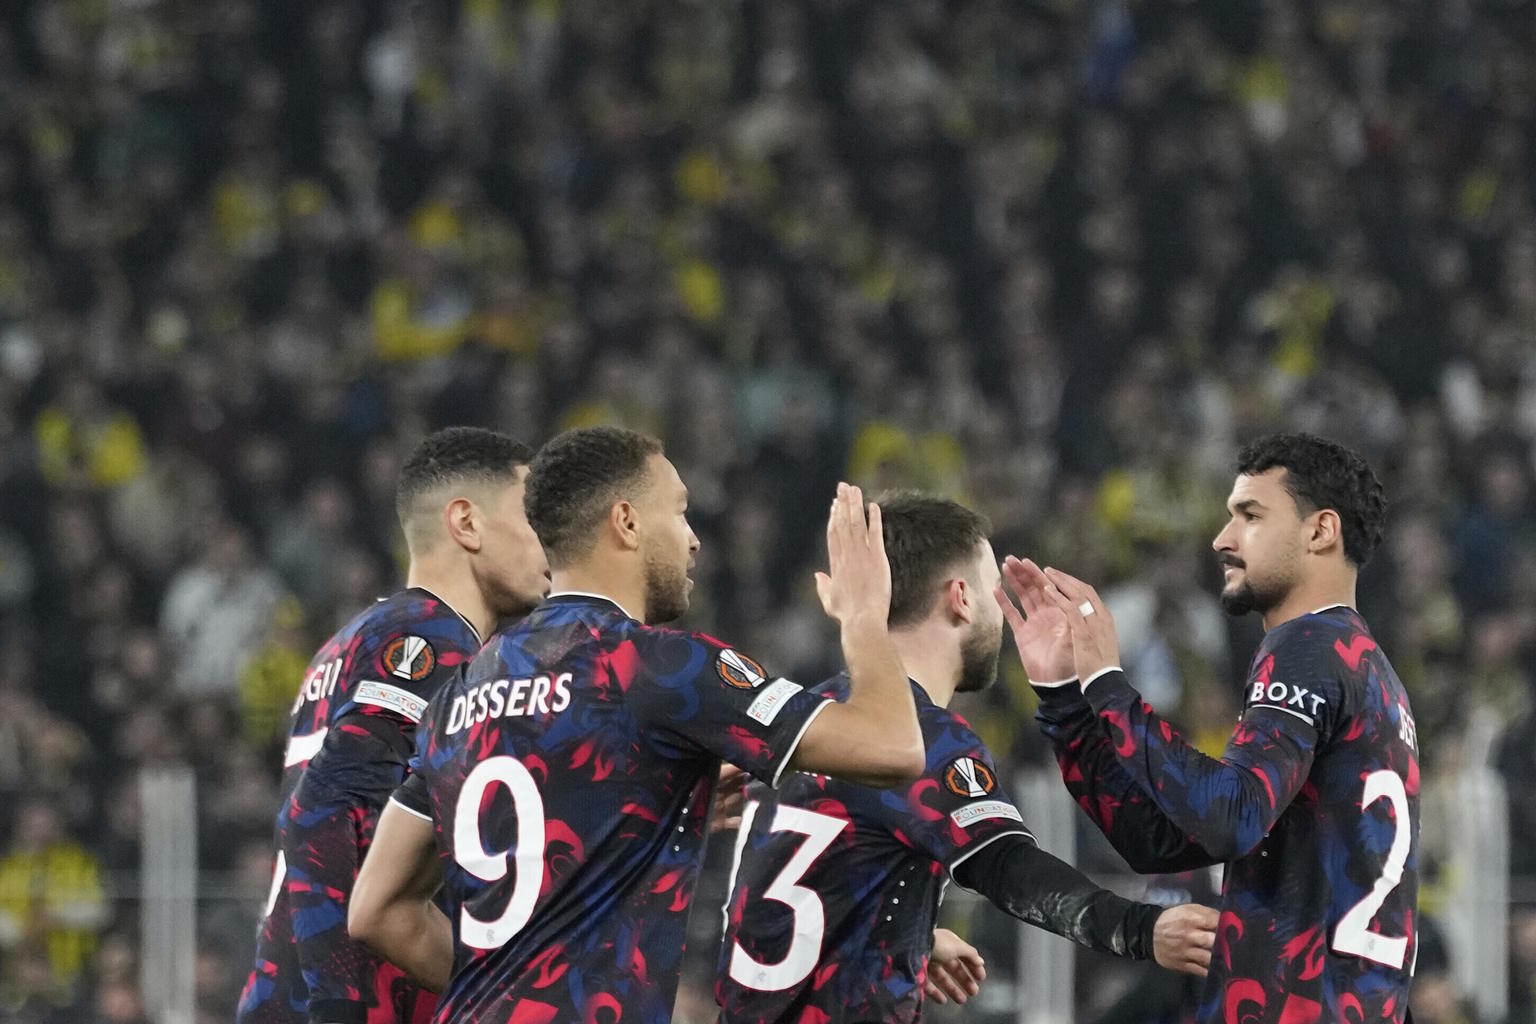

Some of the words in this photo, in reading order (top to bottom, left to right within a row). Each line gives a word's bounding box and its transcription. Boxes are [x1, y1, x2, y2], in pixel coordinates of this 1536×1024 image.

[445, 672, 573, 735] DESSERS
[1250, 681, 1326, 716] BOXT
[453, 756, 546, 950] 9
[722, 800, 850, 992] 3
[1332, 769, 1418, 977] 2
